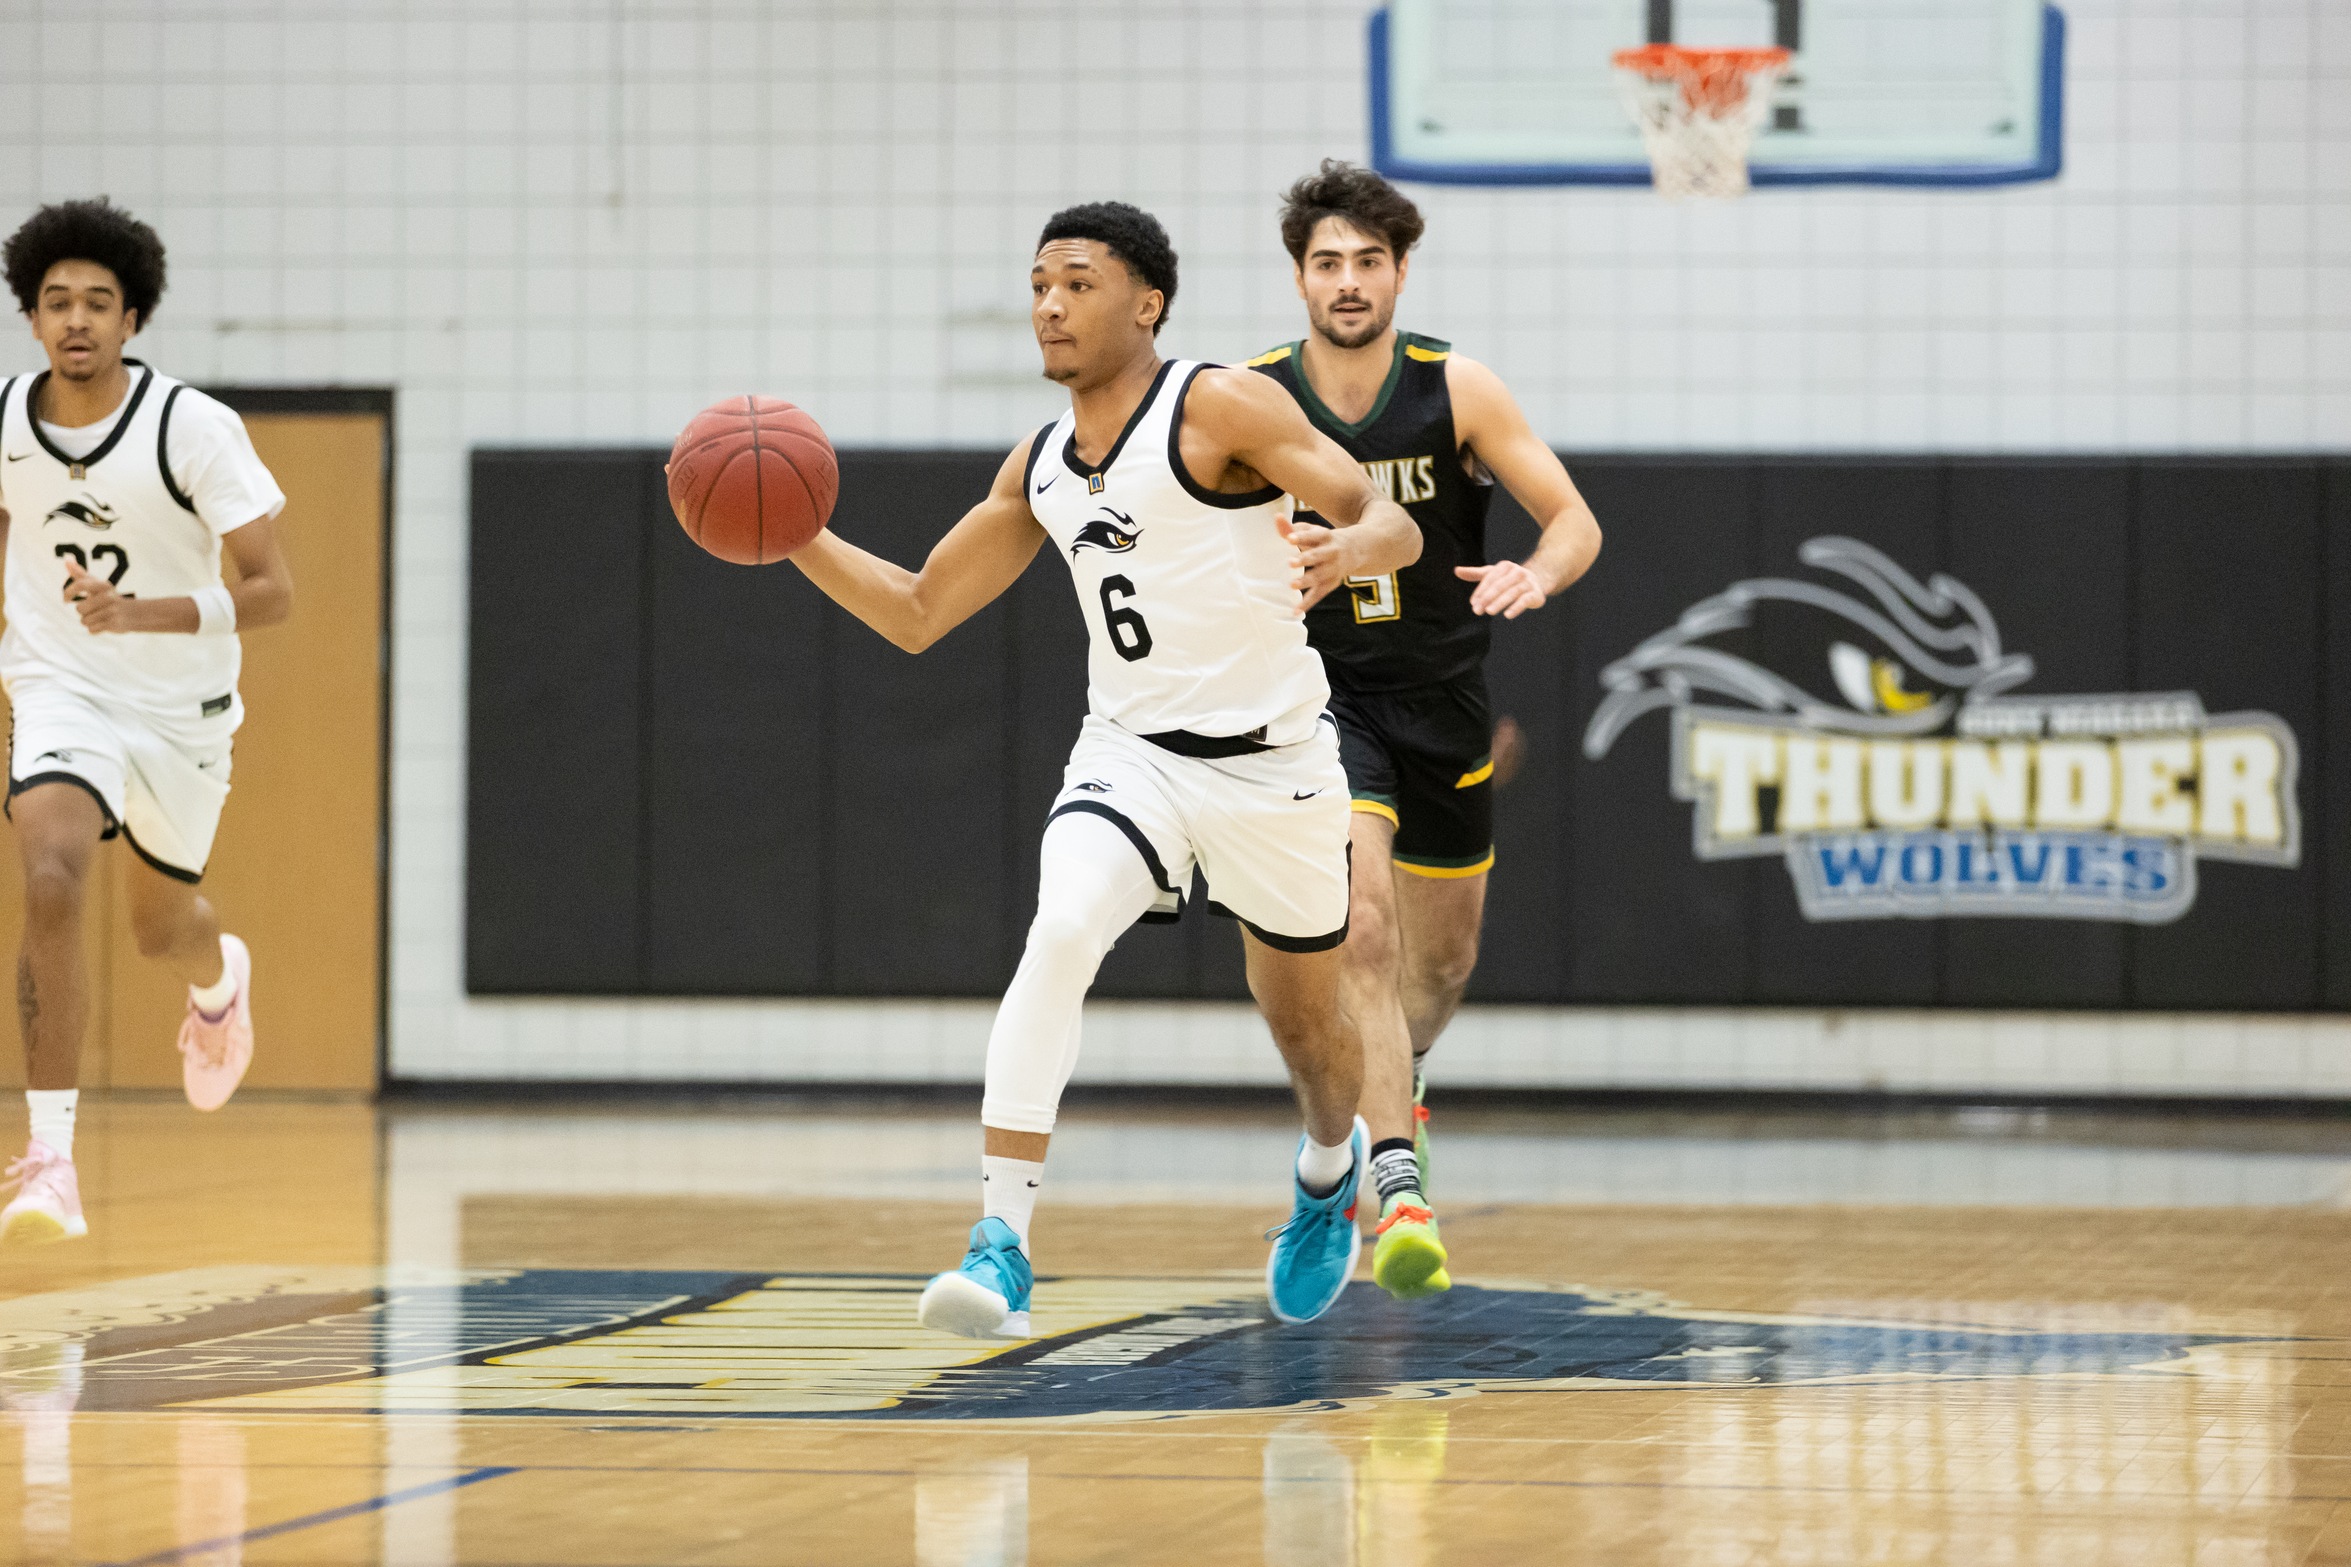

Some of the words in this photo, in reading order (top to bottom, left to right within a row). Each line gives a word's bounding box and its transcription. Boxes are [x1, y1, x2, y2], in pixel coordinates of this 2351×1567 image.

[1100, 574, 1153, 662] 6
[1690, 724, 2284, 842] THUNDER
[1819, 843, 2168, 892] WOLVES
